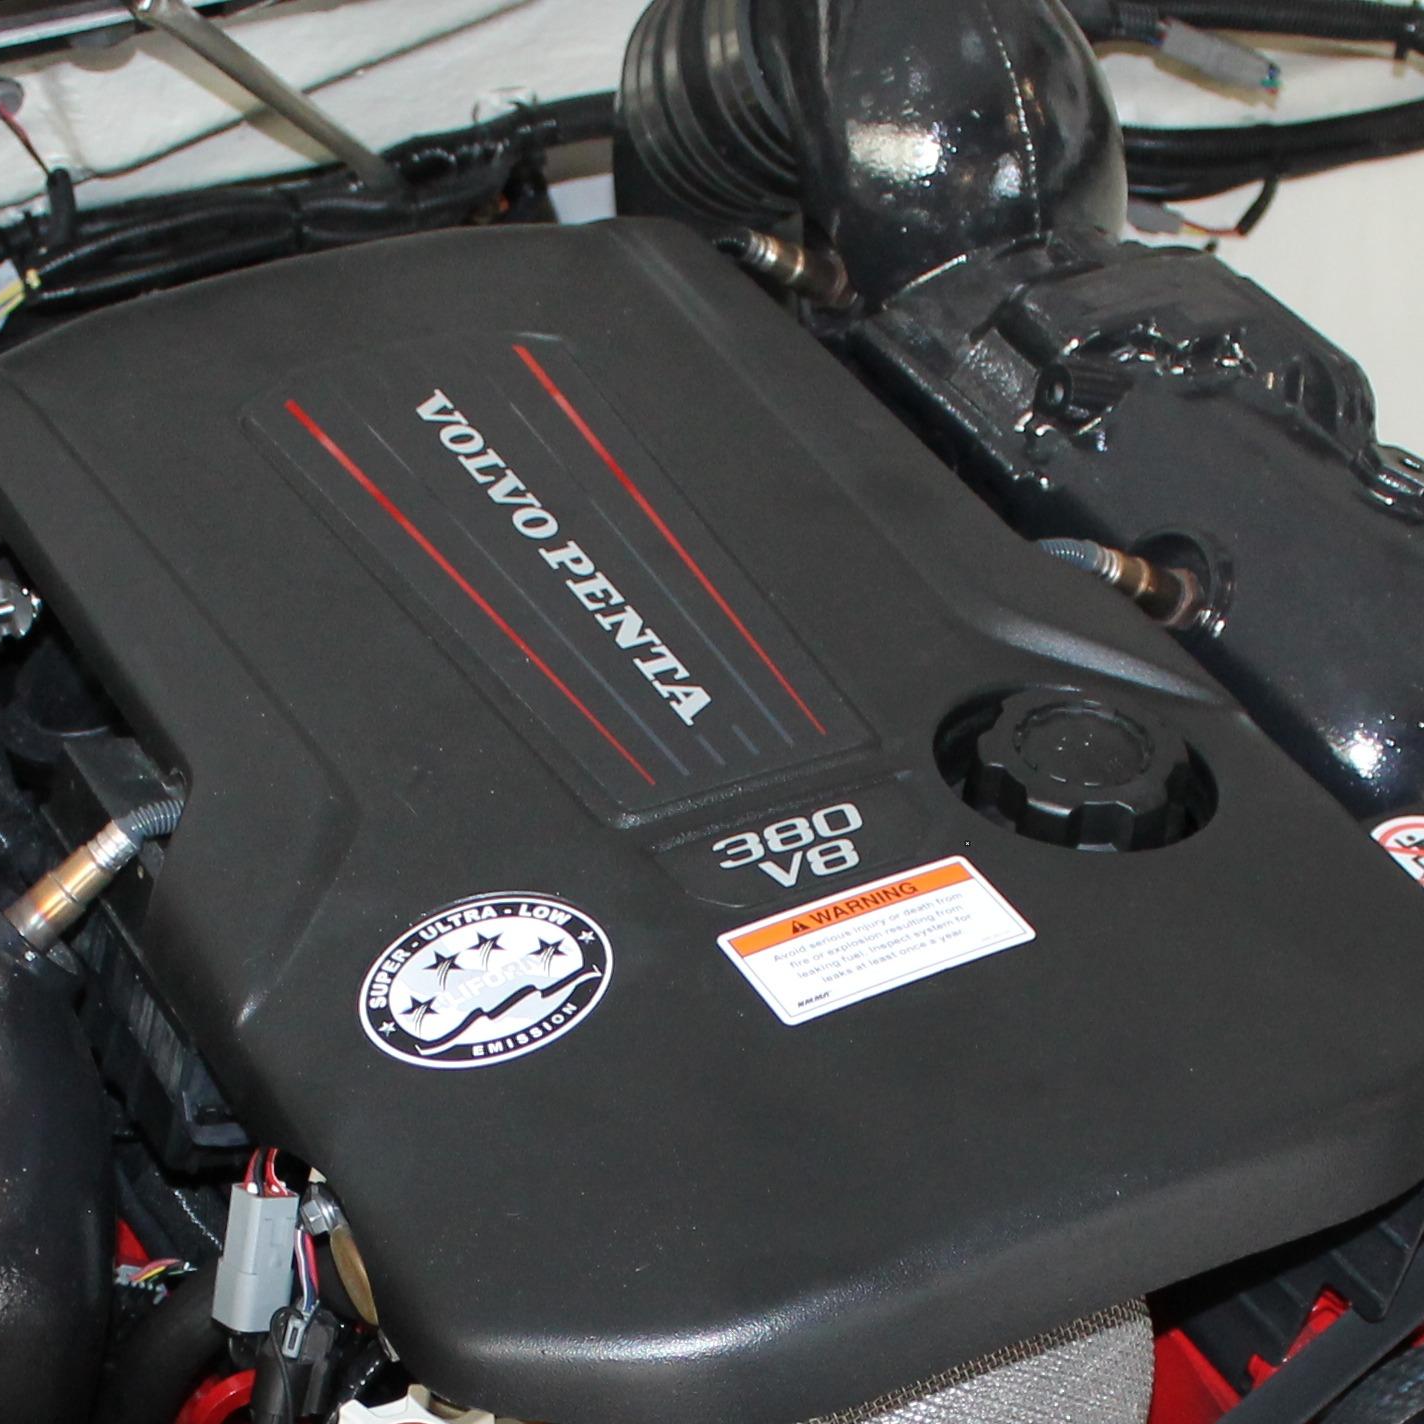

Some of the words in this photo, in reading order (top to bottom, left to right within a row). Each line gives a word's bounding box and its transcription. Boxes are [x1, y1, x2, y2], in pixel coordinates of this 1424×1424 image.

[415, 389, 559, 540] VOLVO
[539, 540, 712, 727] PENTA
[712, 802, 863, 871] 380
[756, 840, 861, 889] V8
[774, 943, 807, 962] Avoid
[809, 929, 851, 951] serious
[853, 917, 887, 934] injury
[888, 913, 901, 922] or
[903, 900, 934, 917] death
[935, 892, 964, 907] from
[789, 956, 812, 968] fire
[812, 951, 825, 961] or
[827, 932, 883, 958] explosion
[884, 916, 936, 939] resulting
[936, 904, 964, 918] from
[810, 882, 918, 925] WARNING
[368, 949, 412, 1010] SUPER
[417, 906, 498, 942] ULTRA
[518, 903, 572, 926] LOW
[797, 961, 841, 979] leaking
[869, 933, 913, 955] Inspect
[913, 918, 953, 938] system
[955, 913, 972, 923] for
[822, 967, 855, 983] leaks
[856, 959, 868, 971] at
[869, 950, 897, 967] least
[899, 941, 929, 955] once
[472, 1001, 578, 1057] EMISSION
